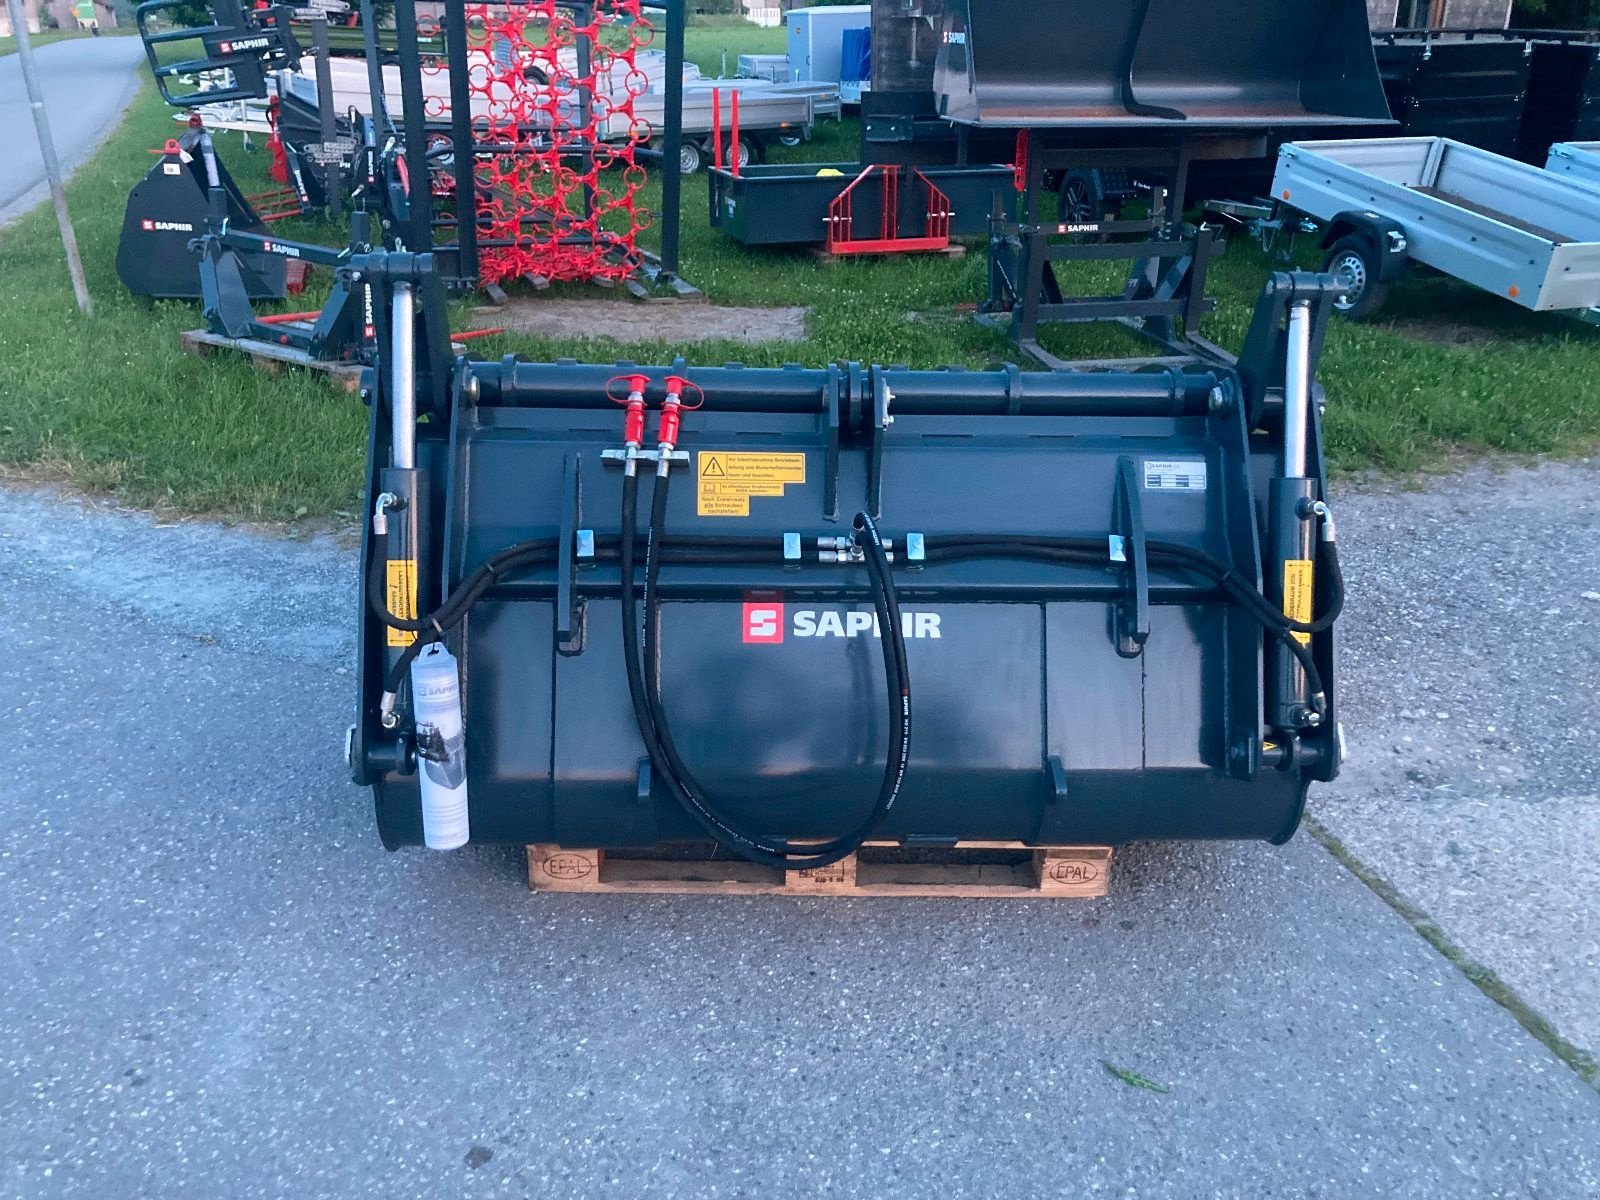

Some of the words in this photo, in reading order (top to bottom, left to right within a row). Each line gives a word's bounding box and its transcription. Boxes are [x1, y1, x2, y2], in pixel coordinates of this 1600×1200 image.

[231, 38, 269, 50] SAPHIR
[155, 221, 193, 231] SAPHIR
[1067, 224, 1098, 232] SAPHIR
[272, 243, 300, 257] SAPHIR
[364, 283, 373, 325] SAPHIR
[549, 859, 585, 875] EPAL
[1055, 865, 1090, 880] EPAL
